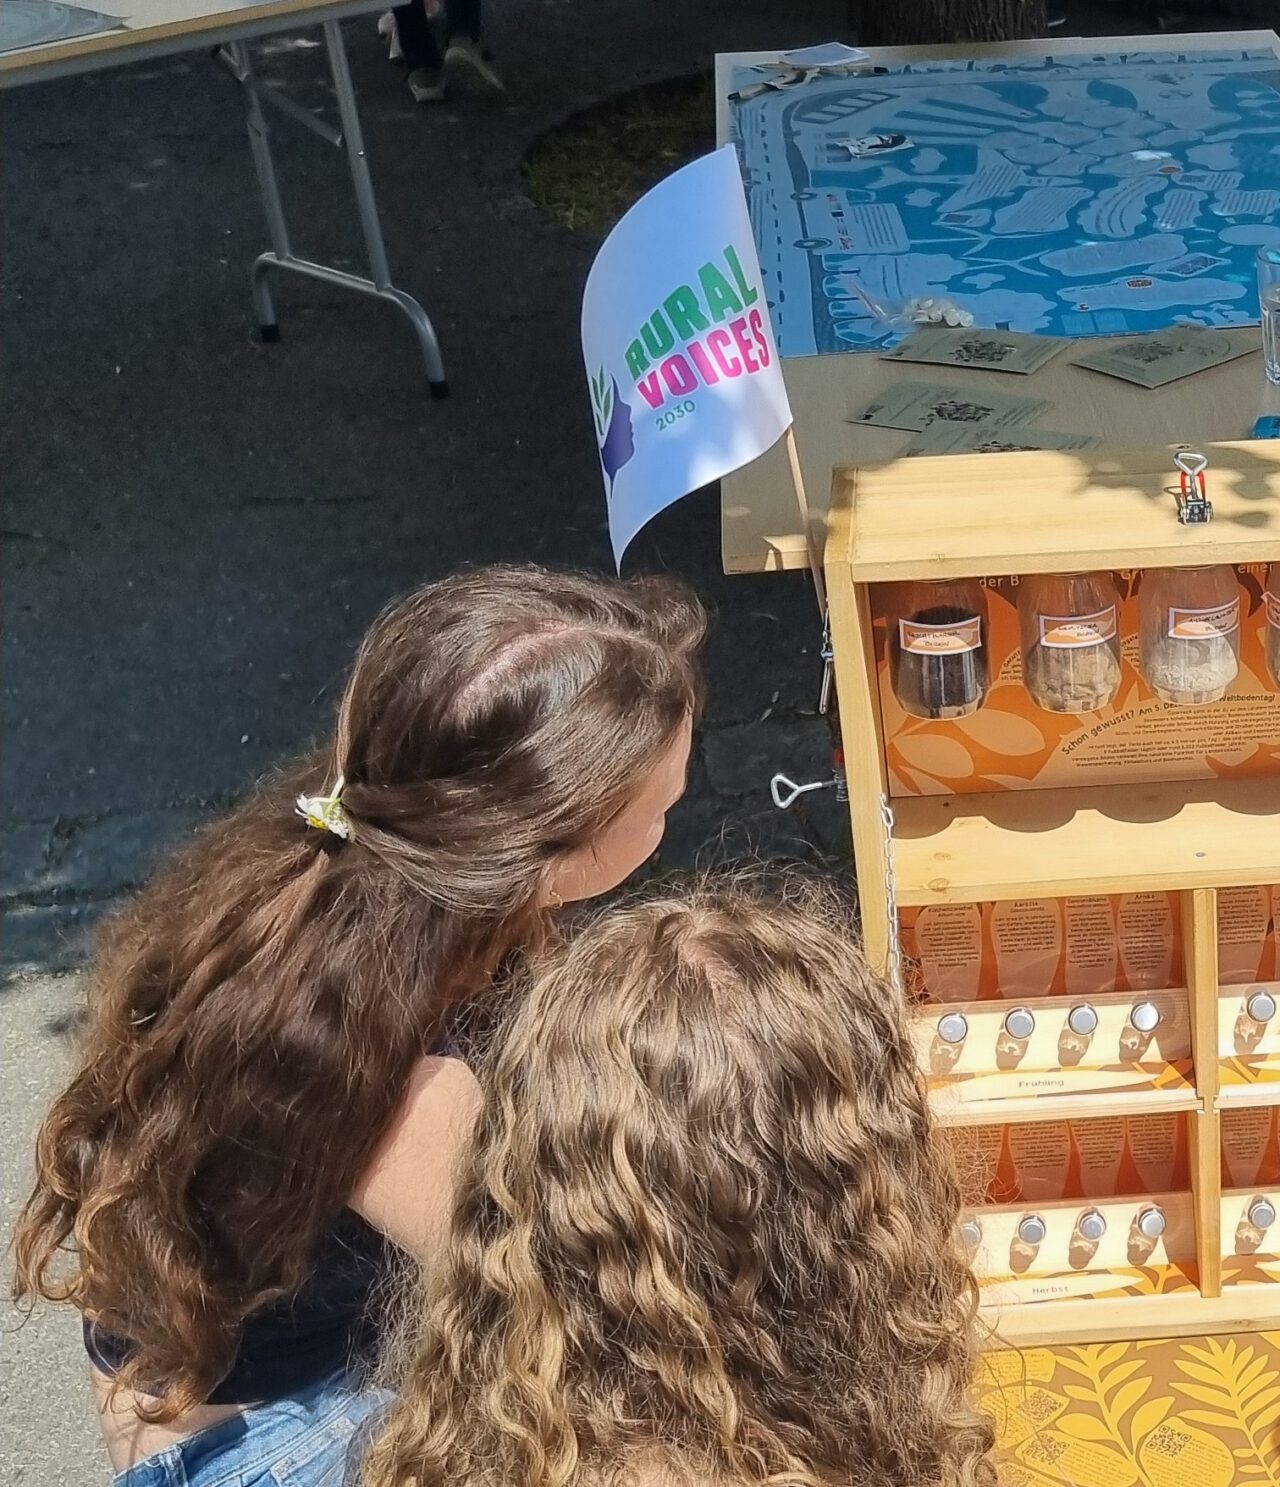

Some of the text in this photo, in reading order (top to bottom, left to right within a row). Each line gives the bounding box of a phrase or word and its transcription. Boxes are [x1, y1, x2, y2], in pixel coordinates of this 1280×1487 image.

[624, 245, 758, 380] RURAL
[637, 308, 770, 409] VOICES
[655, 400, 696, 431] 2030
[979, 576, 1003, 588] der
[1062, 733, 1089, 755] Schon
[1090, 710, 1135, 737] gewusst?
[1139, 708, 1153, 716] Am
[1154, 704, 1162, 712] 5.
[1032, 1286, 1068, 1295] Herbst
